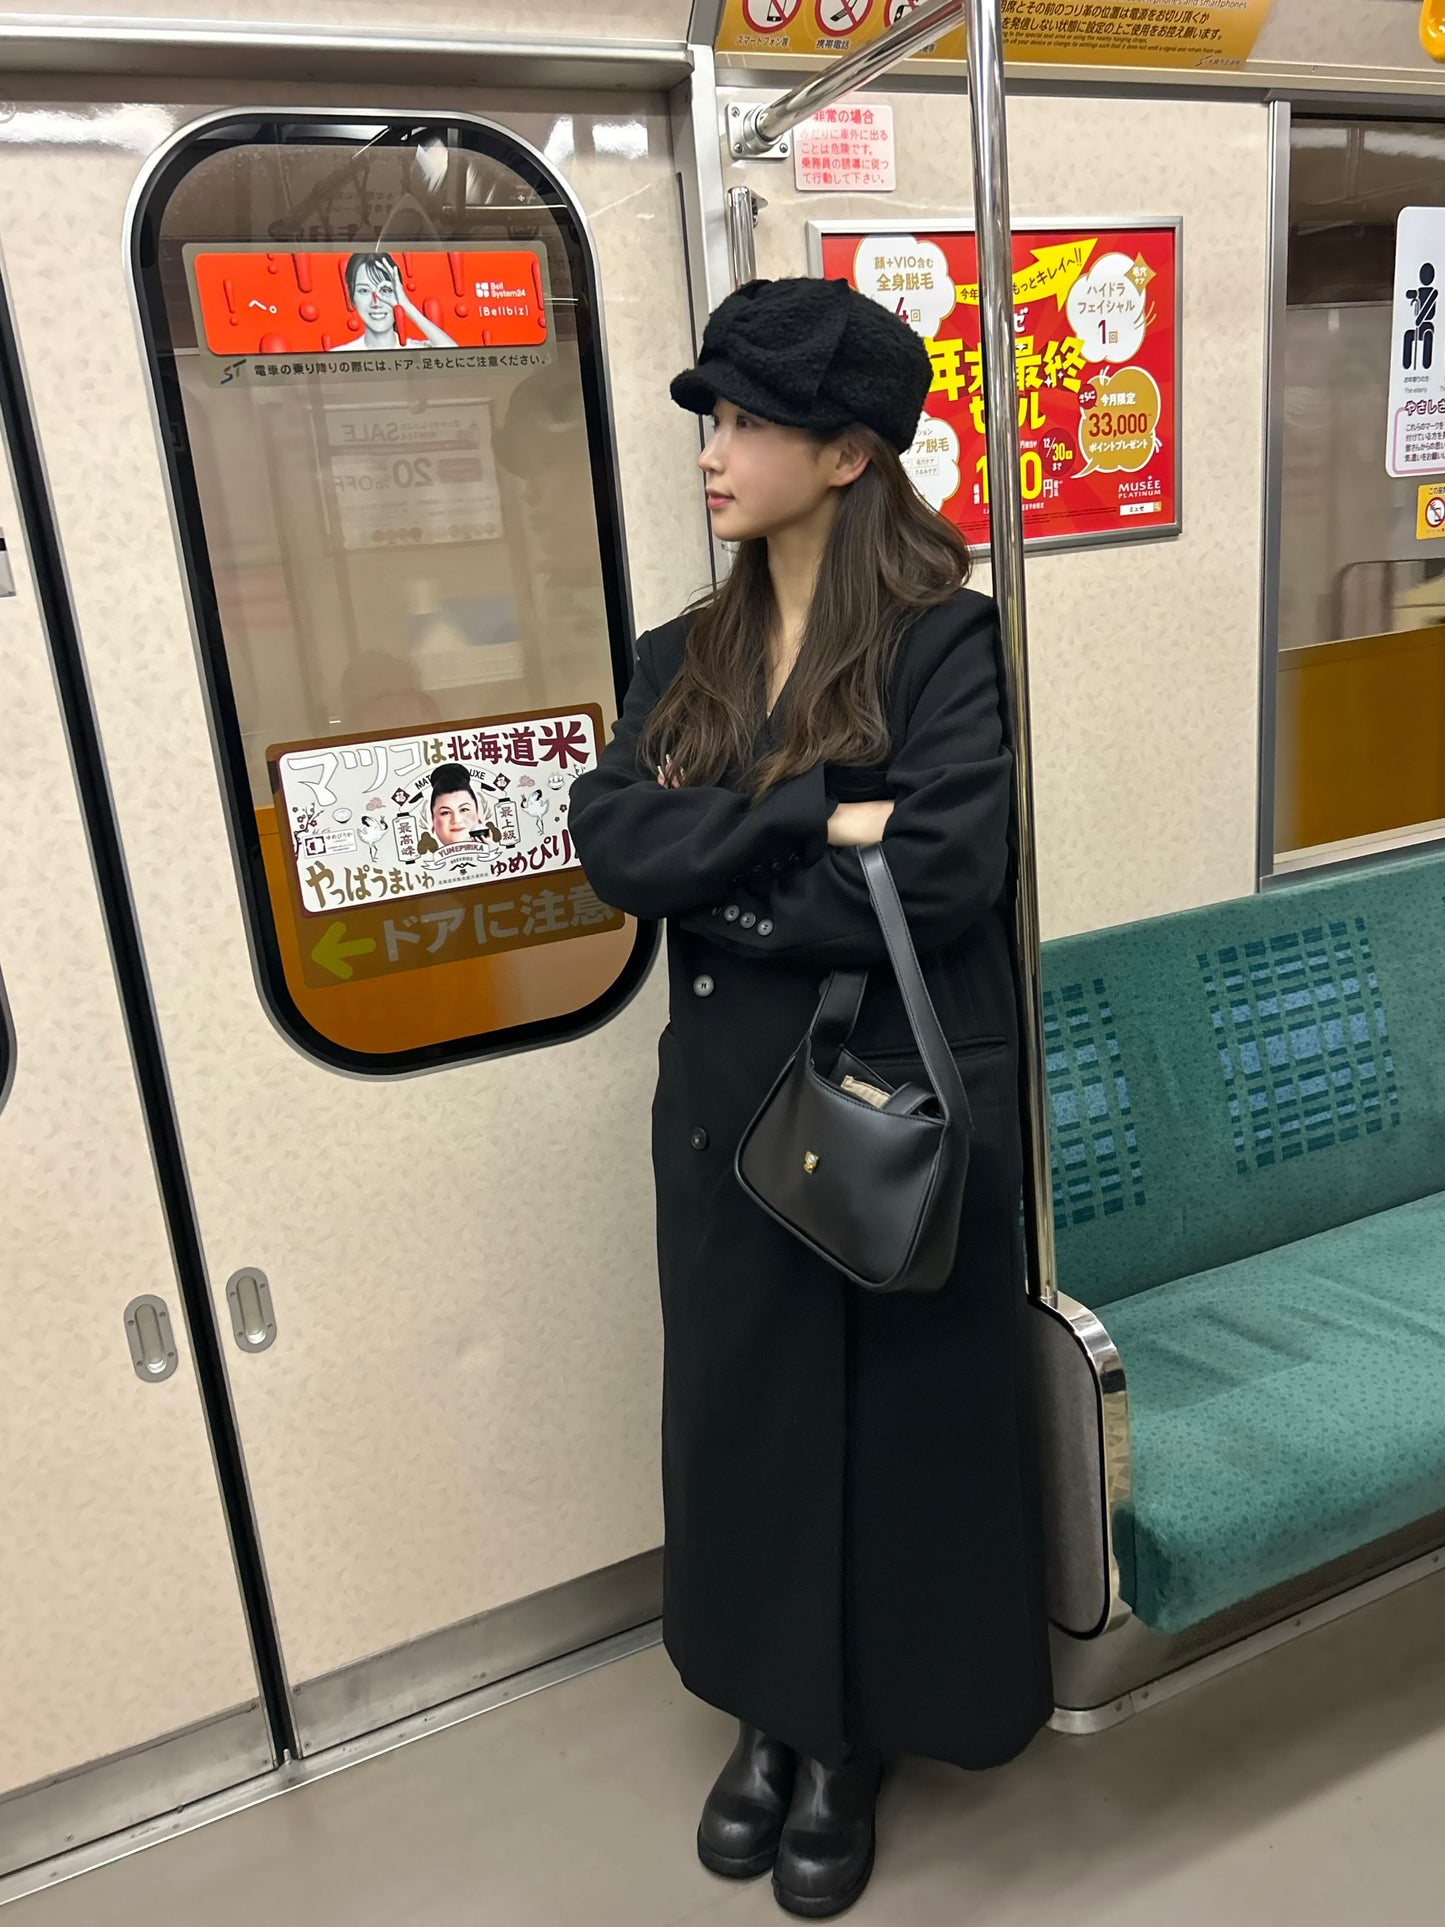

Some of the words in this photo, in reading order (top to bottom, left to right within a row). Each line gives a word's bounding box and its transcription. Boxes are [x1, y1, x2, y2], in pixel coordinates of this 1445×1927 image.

[816, 38, 849, 50] 携帯電話
[814, 108, 874, 125] 非常の場合
[802, 157, 889, 170] 乗務員の誘導に従っ
[803, 172, 884, 185] て行動して下さい。
[876, 272, 934, 291] 全身脱毛
[1087, 281, 1126, 297] ハイドラ
[491, 289, 527, 299] System24
[1077, 300, 1136, 315] フェイシャル
[254, 355, 546, 377] 電車の乗り降りの際には、ドア、足もとにご注意ください。
[1100, 392, 1137, 407] 今月限定
[968, 391, 1047, 435] セル
[1088, 411, 1148, 439] 33,000
[1405, 432, 1445, 441] 付けている方を
[1088, 438, 1149, 453] ポイントプレゼント
[1118, 489, 1161, 499] PLATINUM
[501, 806, 517, 841] 最上級
[399, 821, 416, 858] 最高峰
[438, 843, 485, 858] YUMEPIRIKA
[490, 829, 577, 878] ゆめぴり
[305, 860, 436, 909] やっぱうまいわ
[384, 885, 616, 962] ドアに注意
